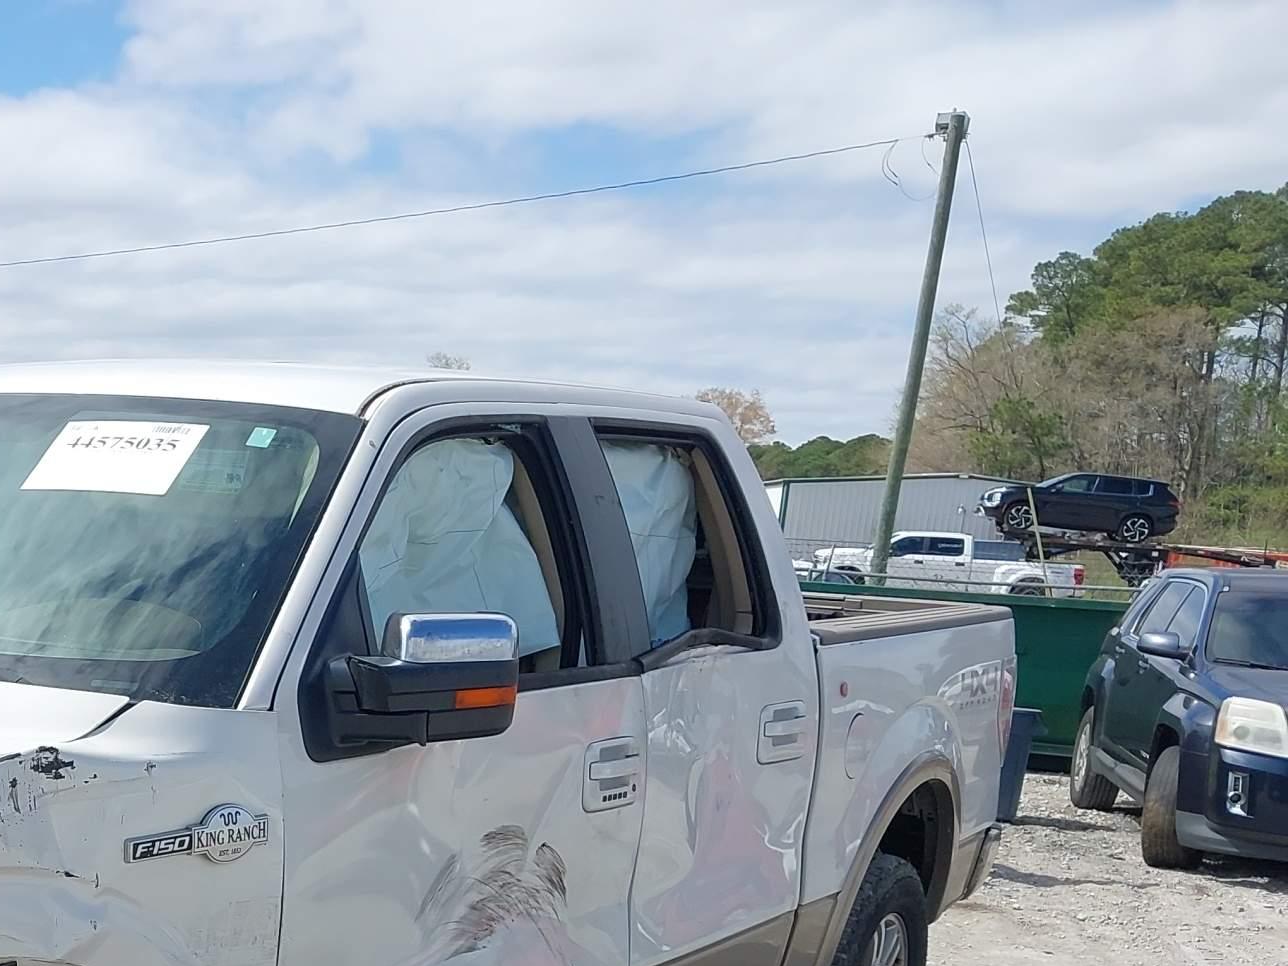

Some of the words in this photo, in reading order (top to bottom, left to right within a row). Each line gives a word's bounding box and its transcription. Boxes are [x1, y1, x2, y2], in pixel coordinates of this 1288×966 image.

[67, 435, 181, 452] 44575035
[196, 829, 225, 849] KING
[227, 820, 267, 844] RANCH
[135, 836, 191, 858] F-150
